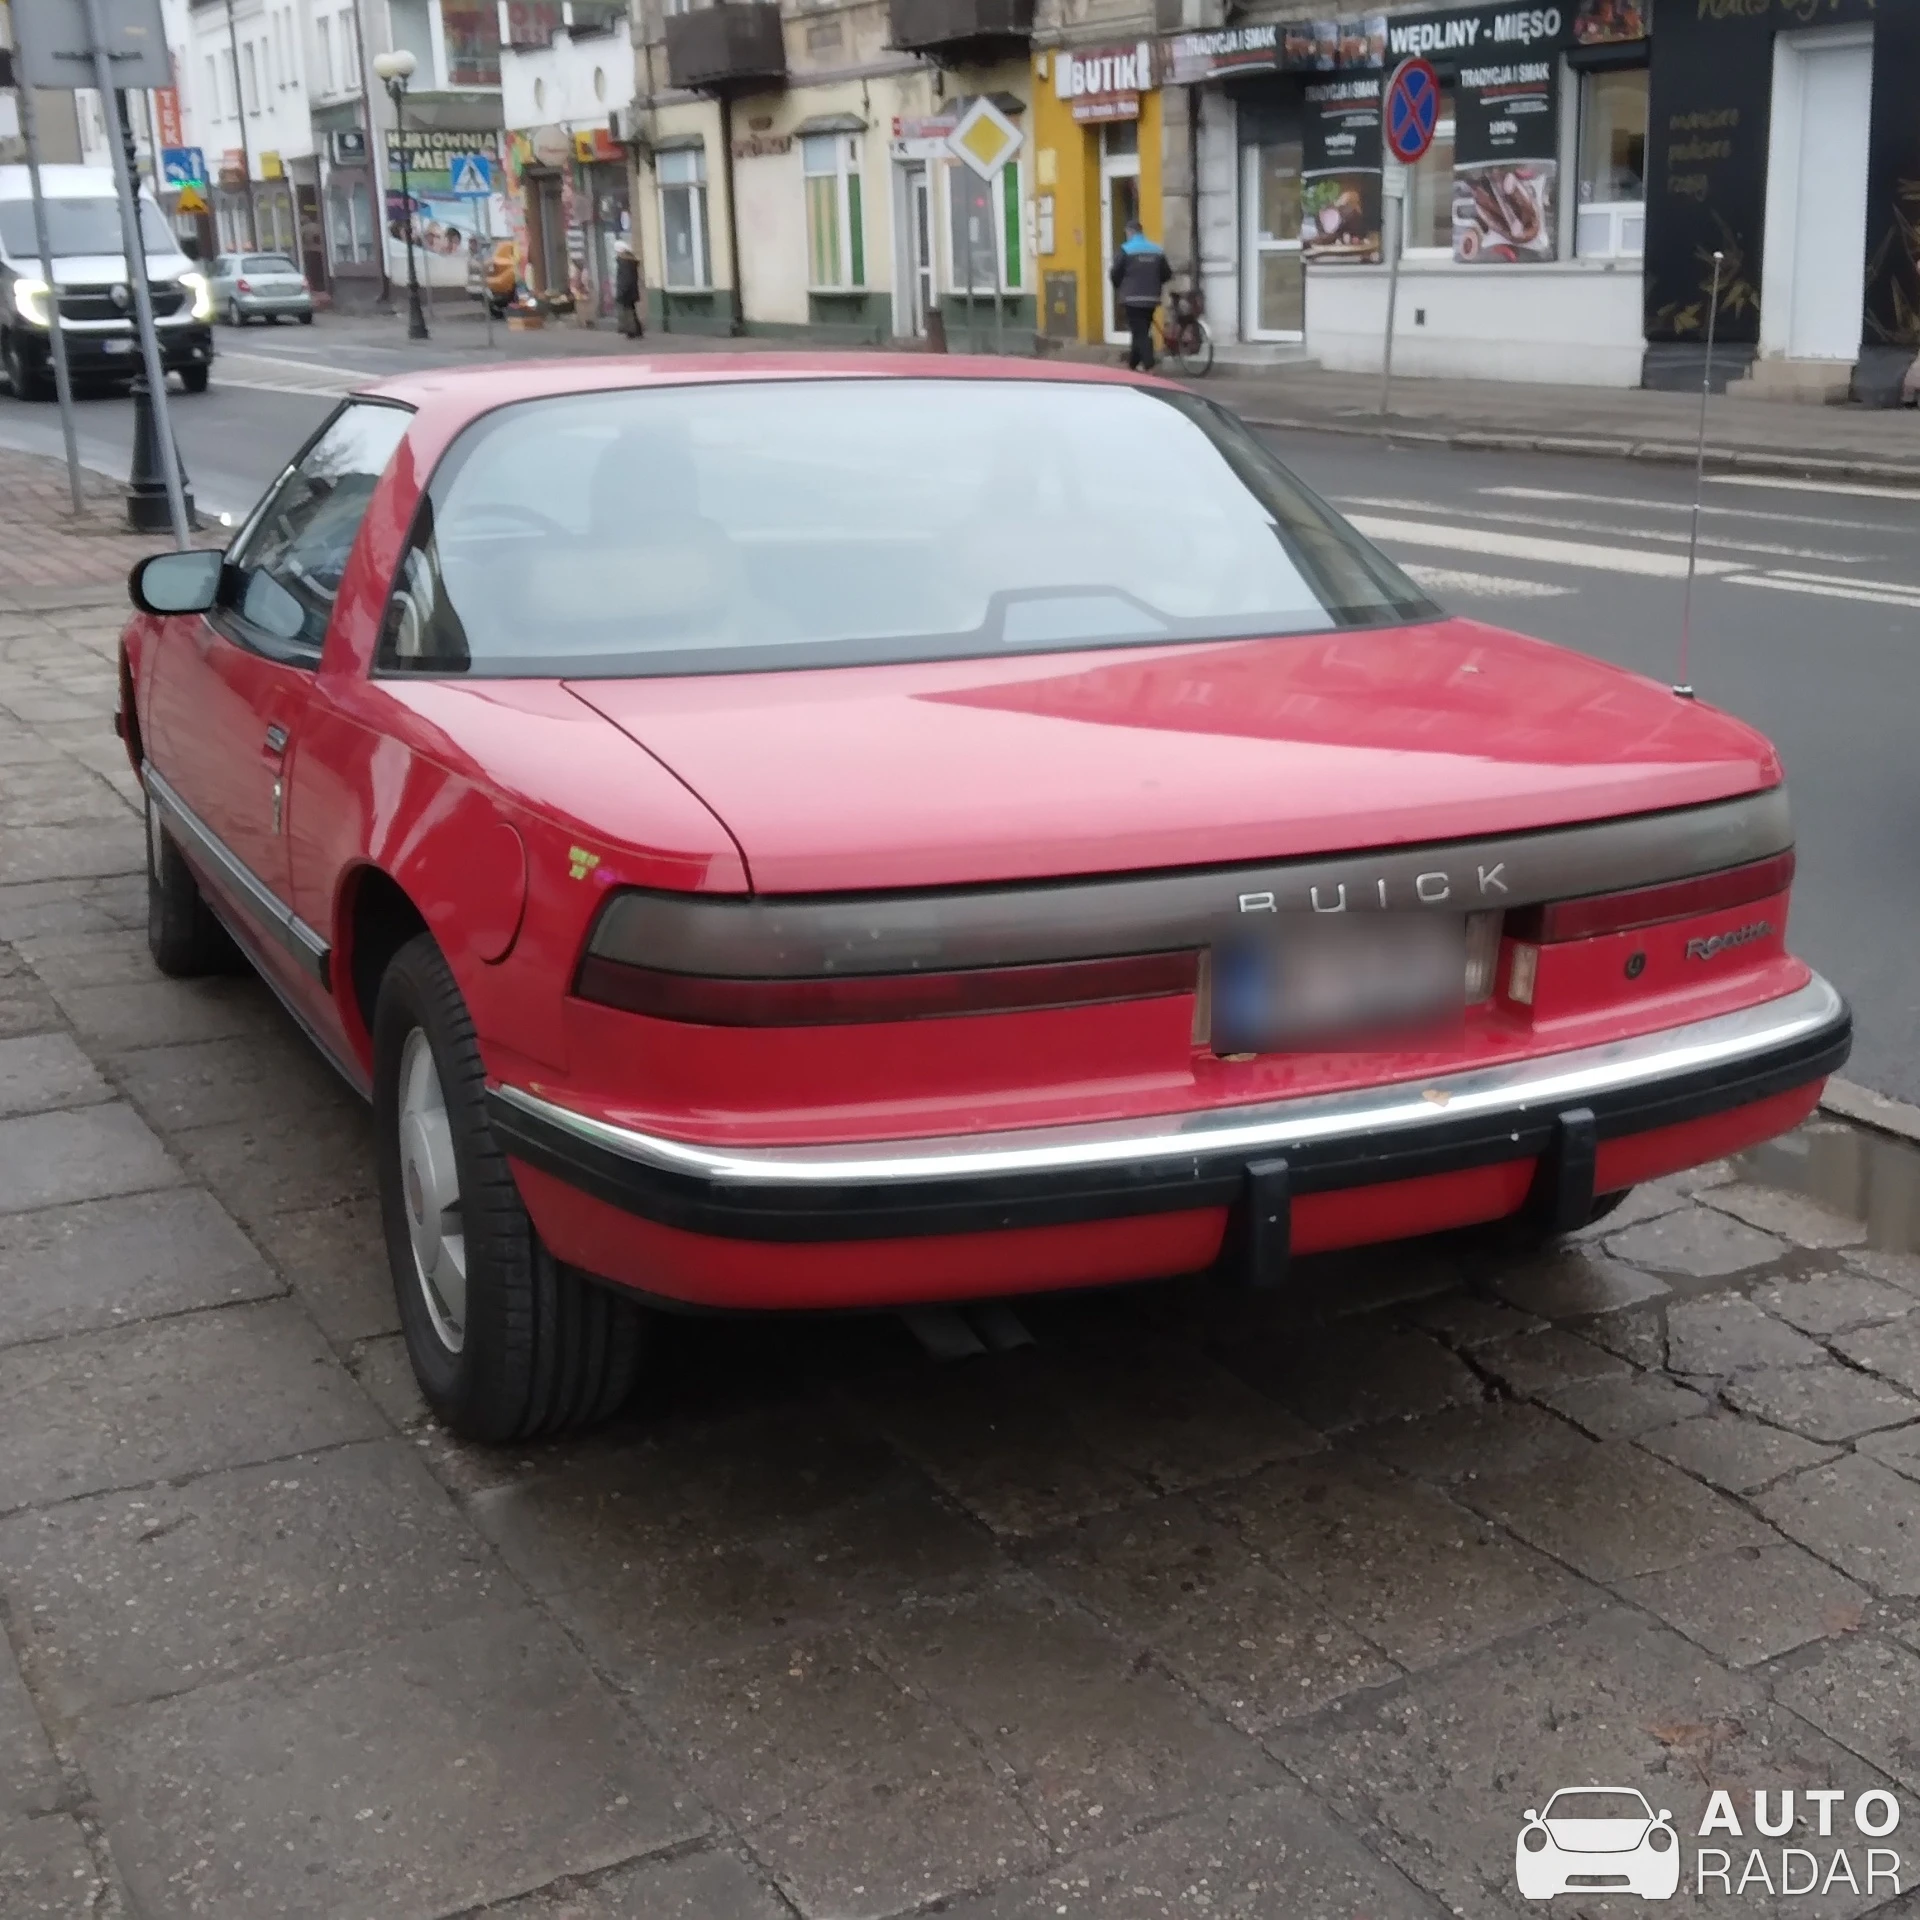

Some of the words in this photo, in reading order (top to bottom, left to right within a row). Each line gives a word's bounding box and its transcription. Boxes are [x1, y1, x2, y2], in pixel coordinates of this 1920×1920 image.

[1246, 25, 1276, 50] SMAK
[1390, 18, 1480, 57] WĘDLINY
[1494, 7, 1561, 45] MIĘSO
[1071, 54, 1138, 95] BUTIK
[1461, 66, 1511, 87] TRADYCJA
[1519, 63, 1549, 83] SMAK
